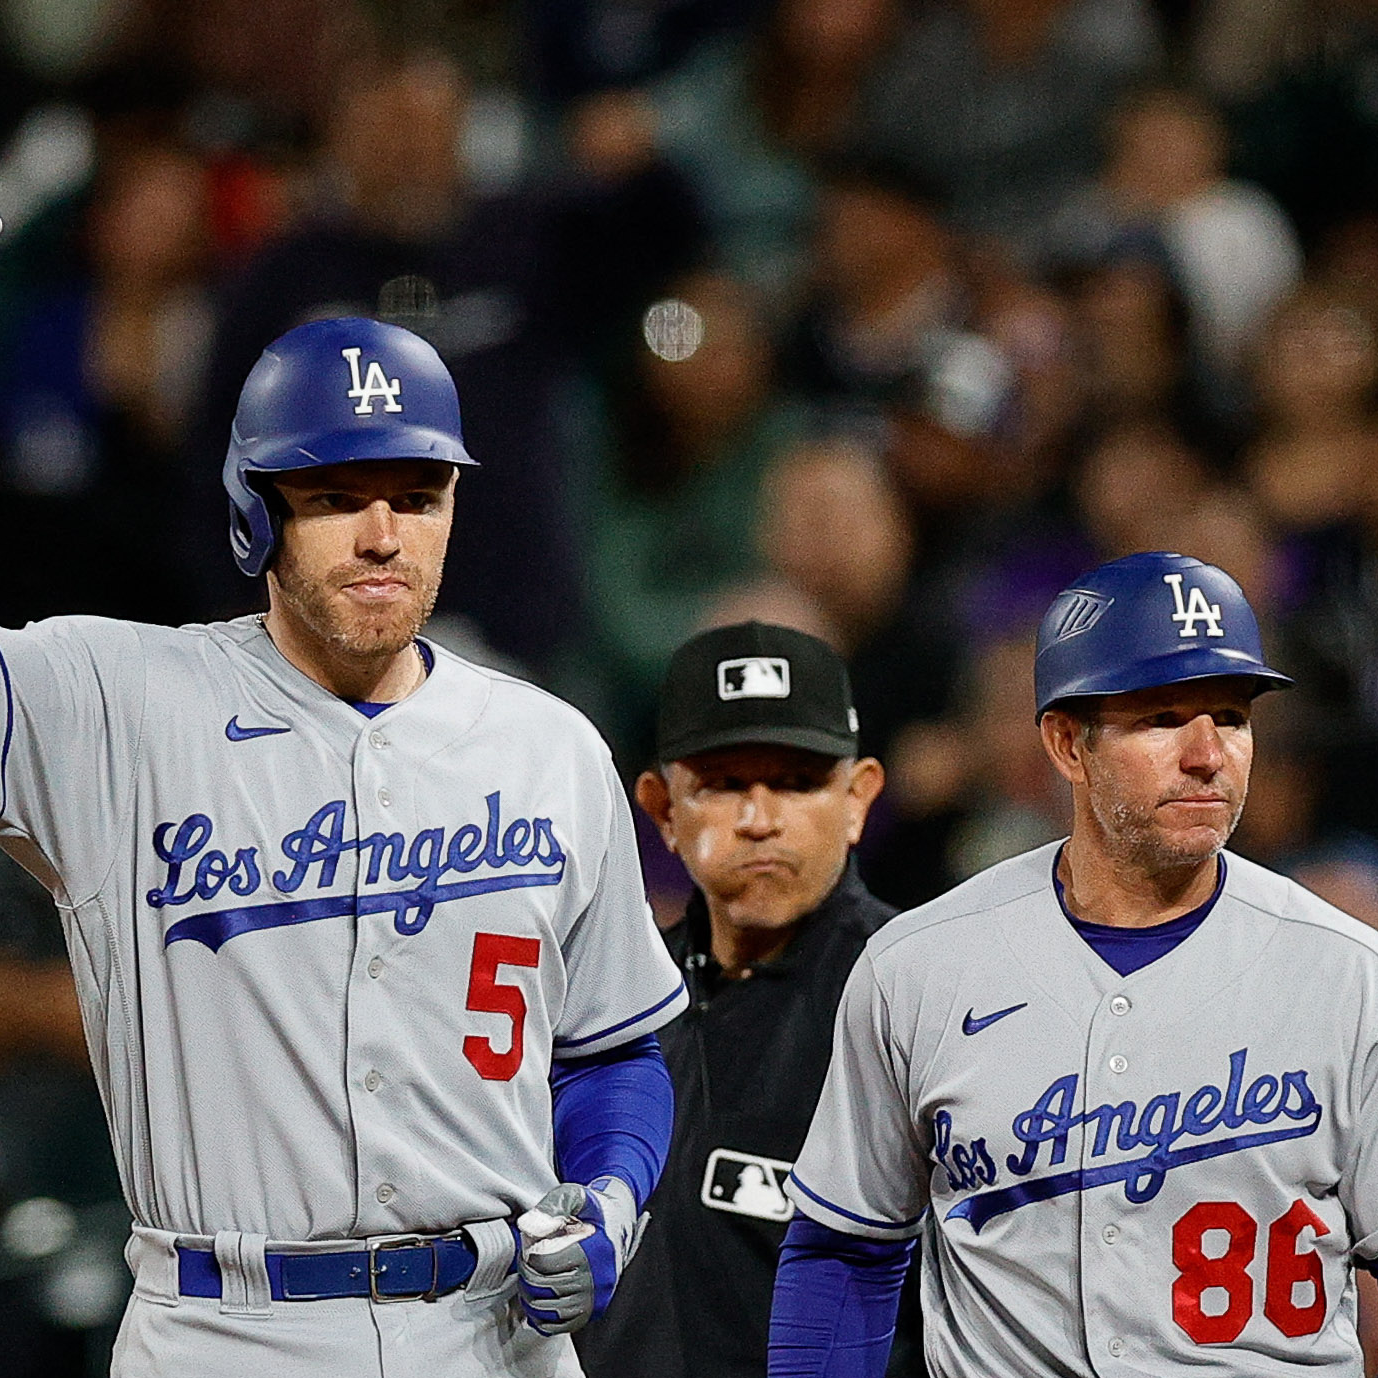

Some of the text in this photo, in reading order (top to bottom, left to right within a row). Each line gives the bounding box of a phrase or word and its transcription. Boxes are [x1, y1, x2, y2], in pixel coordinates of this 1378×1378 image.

[341, 347, 403, 415] LA
[1163, 573, 1225, 637] LA
[146, 790, 566, 936] Los Angeles
[461, 931, 542, 1083] 5
[1006, 1047, 1323, 1204] Angeles
[1171, 1197, 1332, 1345] 86
